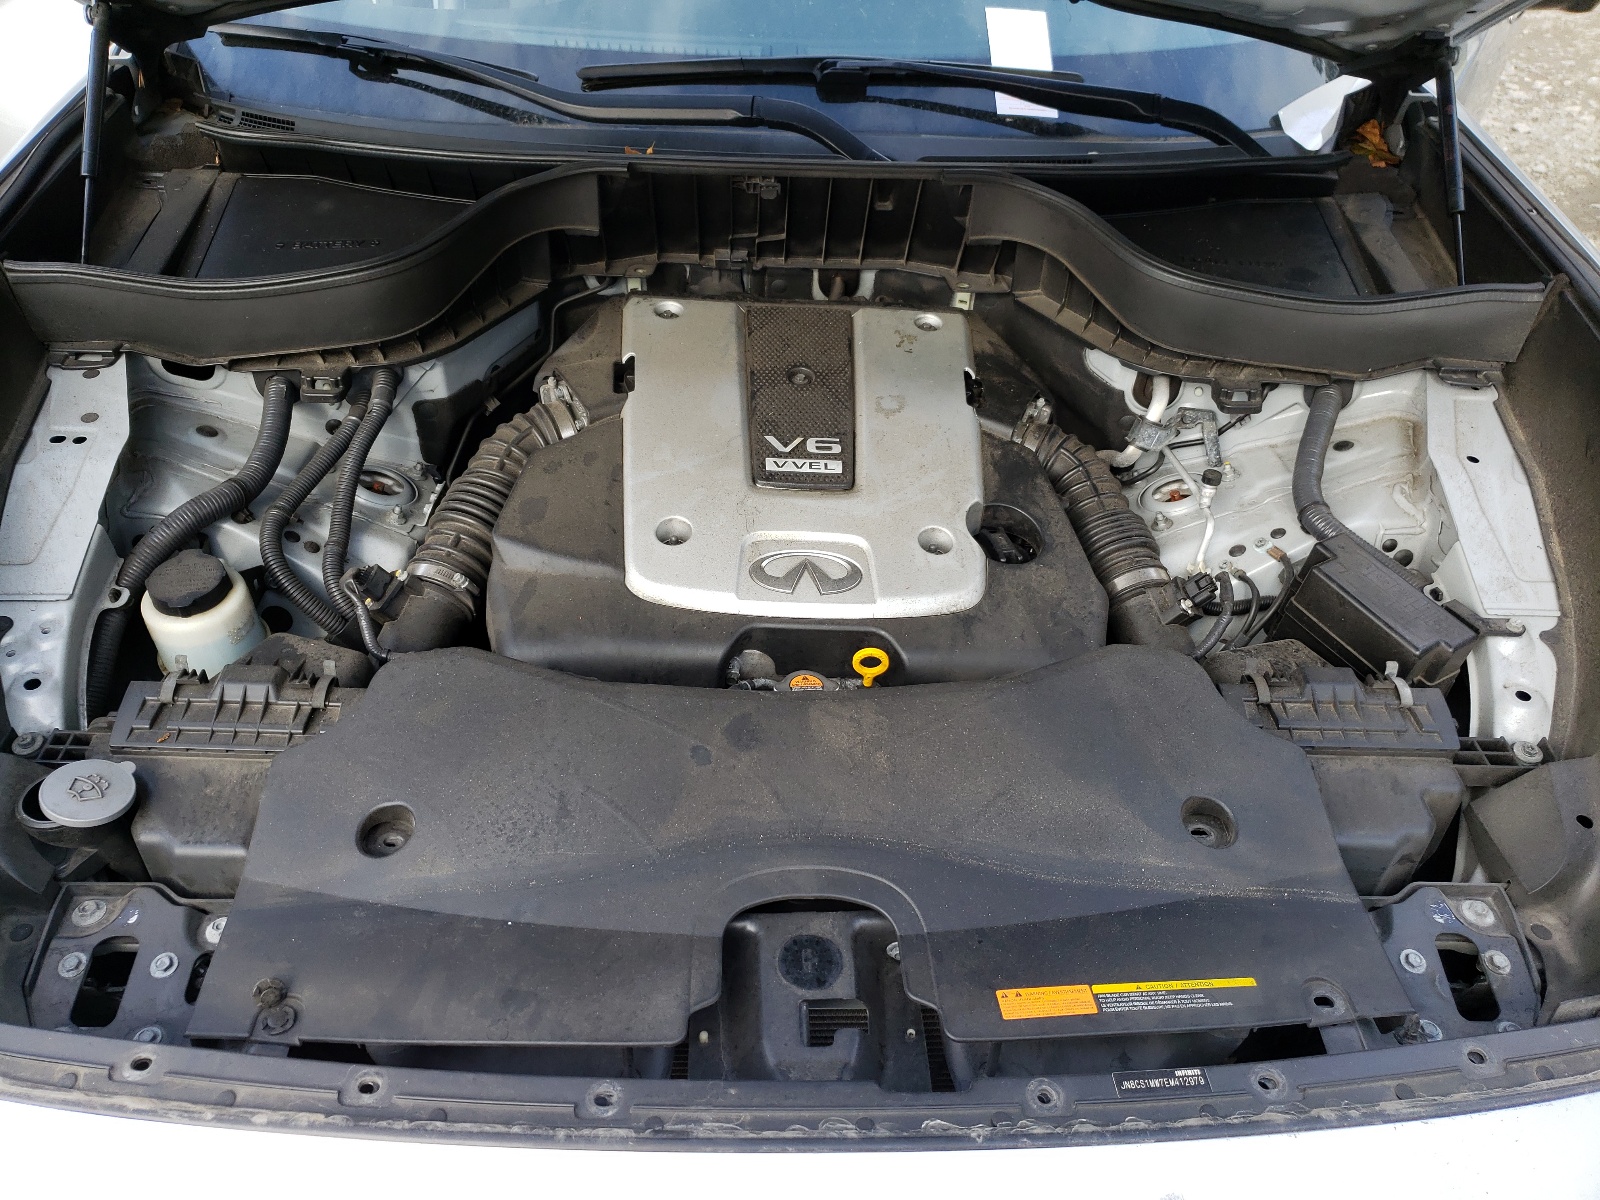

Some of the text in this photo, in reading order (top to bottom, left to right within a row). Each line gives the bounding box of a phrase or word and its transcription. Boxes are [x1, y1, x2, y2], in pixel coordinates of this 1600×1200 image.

[764, 435, 842, 454] V6
[773, 460, 836, 471] VVEL
[1121, 1076, 1205, 1090] JN8CS1MW7EM412979
